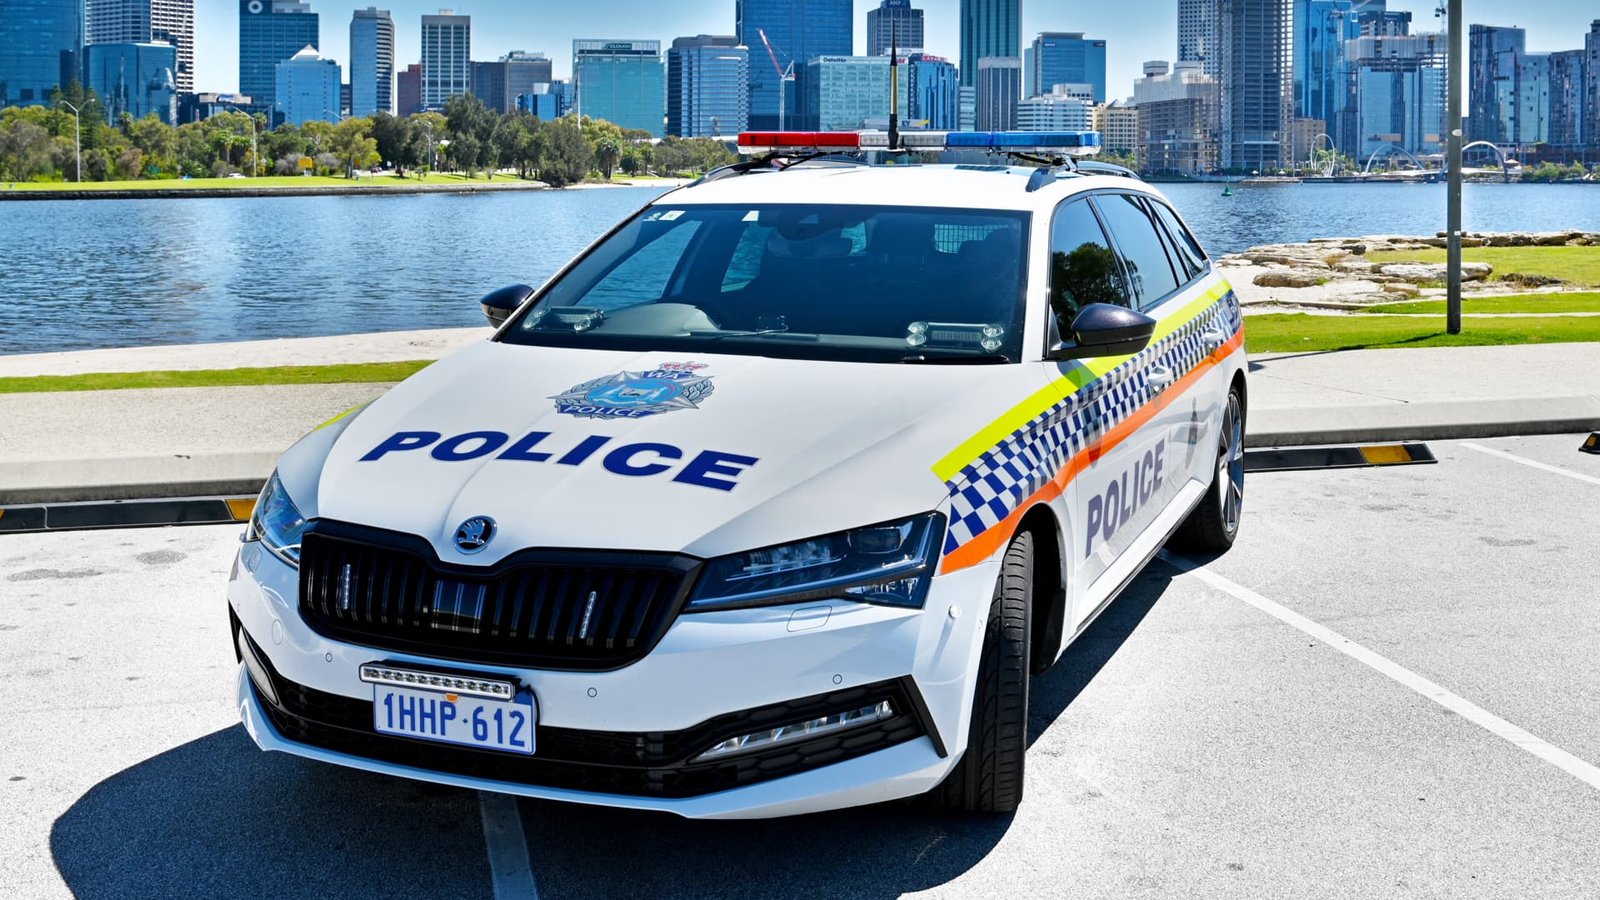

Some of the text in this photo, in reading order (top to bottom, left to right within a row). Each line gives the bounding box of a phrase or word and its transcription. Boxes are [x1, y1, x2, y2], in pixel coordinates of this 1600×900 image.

[646, 371, 680, 379] WA
[563, 405, 644, 417] POLICE
[358, 431, 760, 492] POLICE
[1085, 438, 1165, 559] POLICE
